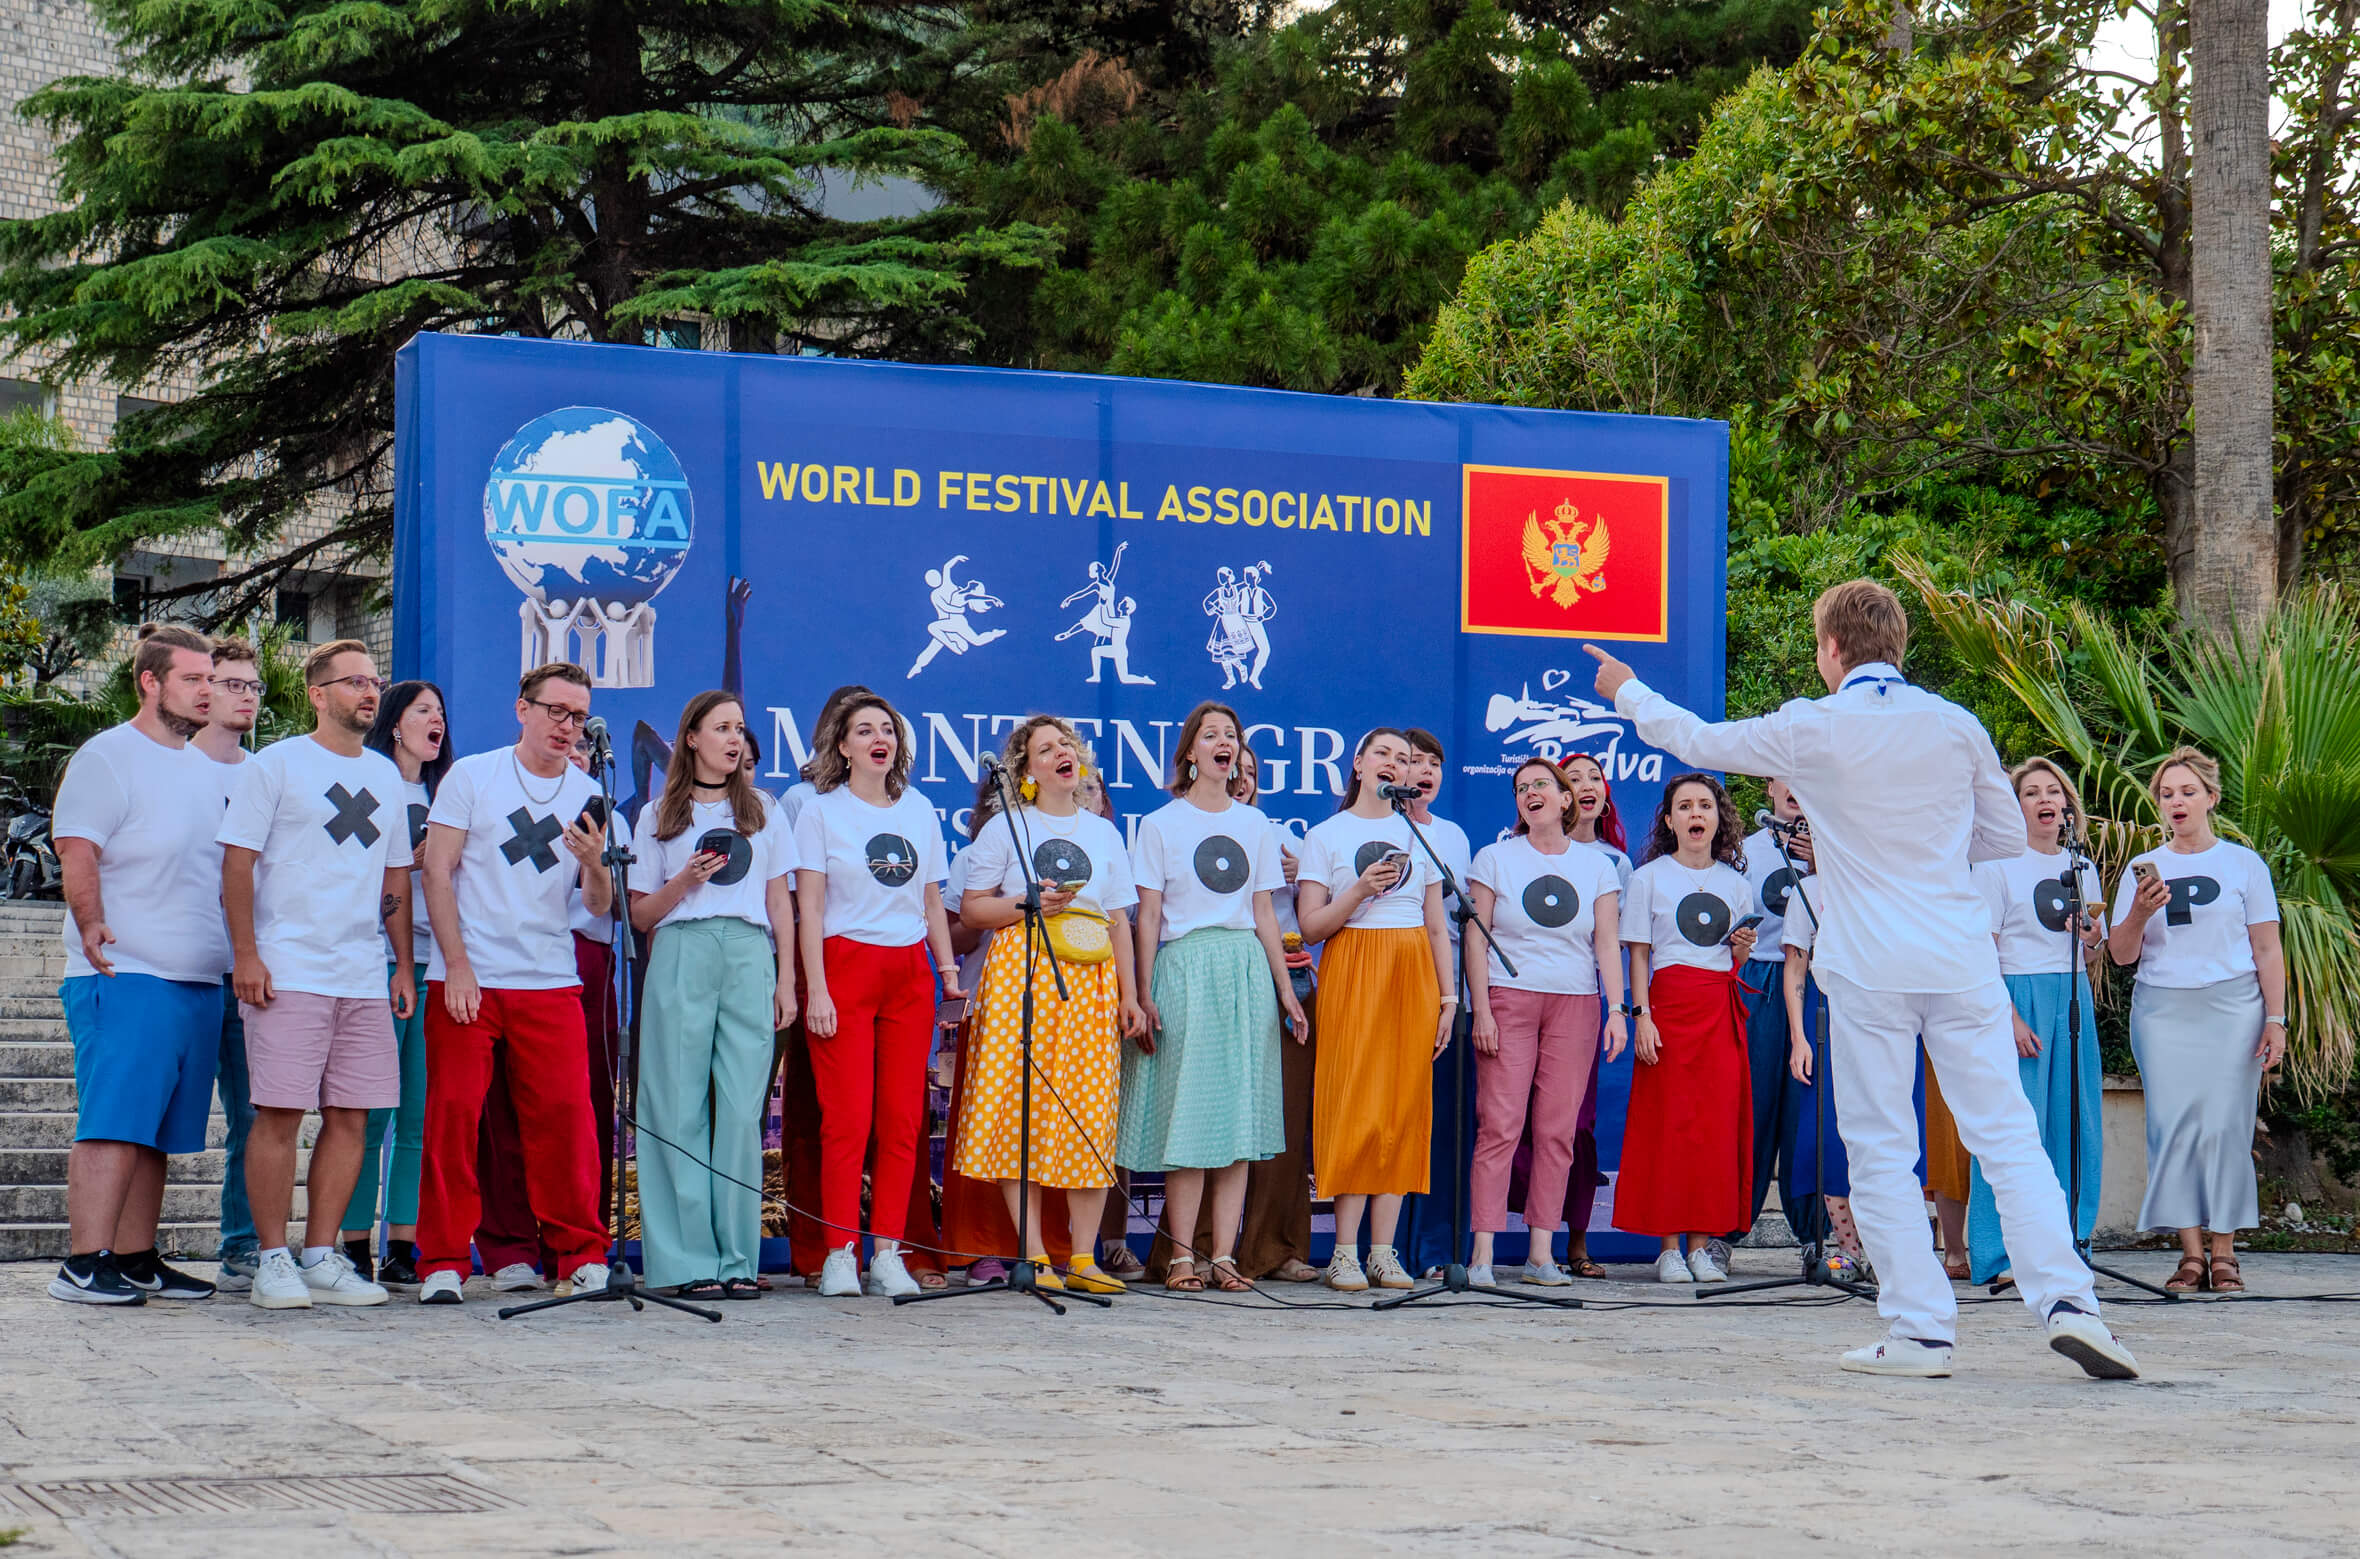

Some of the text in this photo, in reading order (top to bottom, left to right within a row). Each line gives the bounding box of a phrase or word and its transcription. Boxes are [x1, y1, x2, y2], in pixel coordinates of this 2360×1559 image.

[488, 482, 690, 540] WOFA
[758, 462, 1431, 537] WORLD FESTIVAL ASSOCIATION
[1532, 736, 1663, 782] Bdva
[2164, 876, 2221, 926] P
